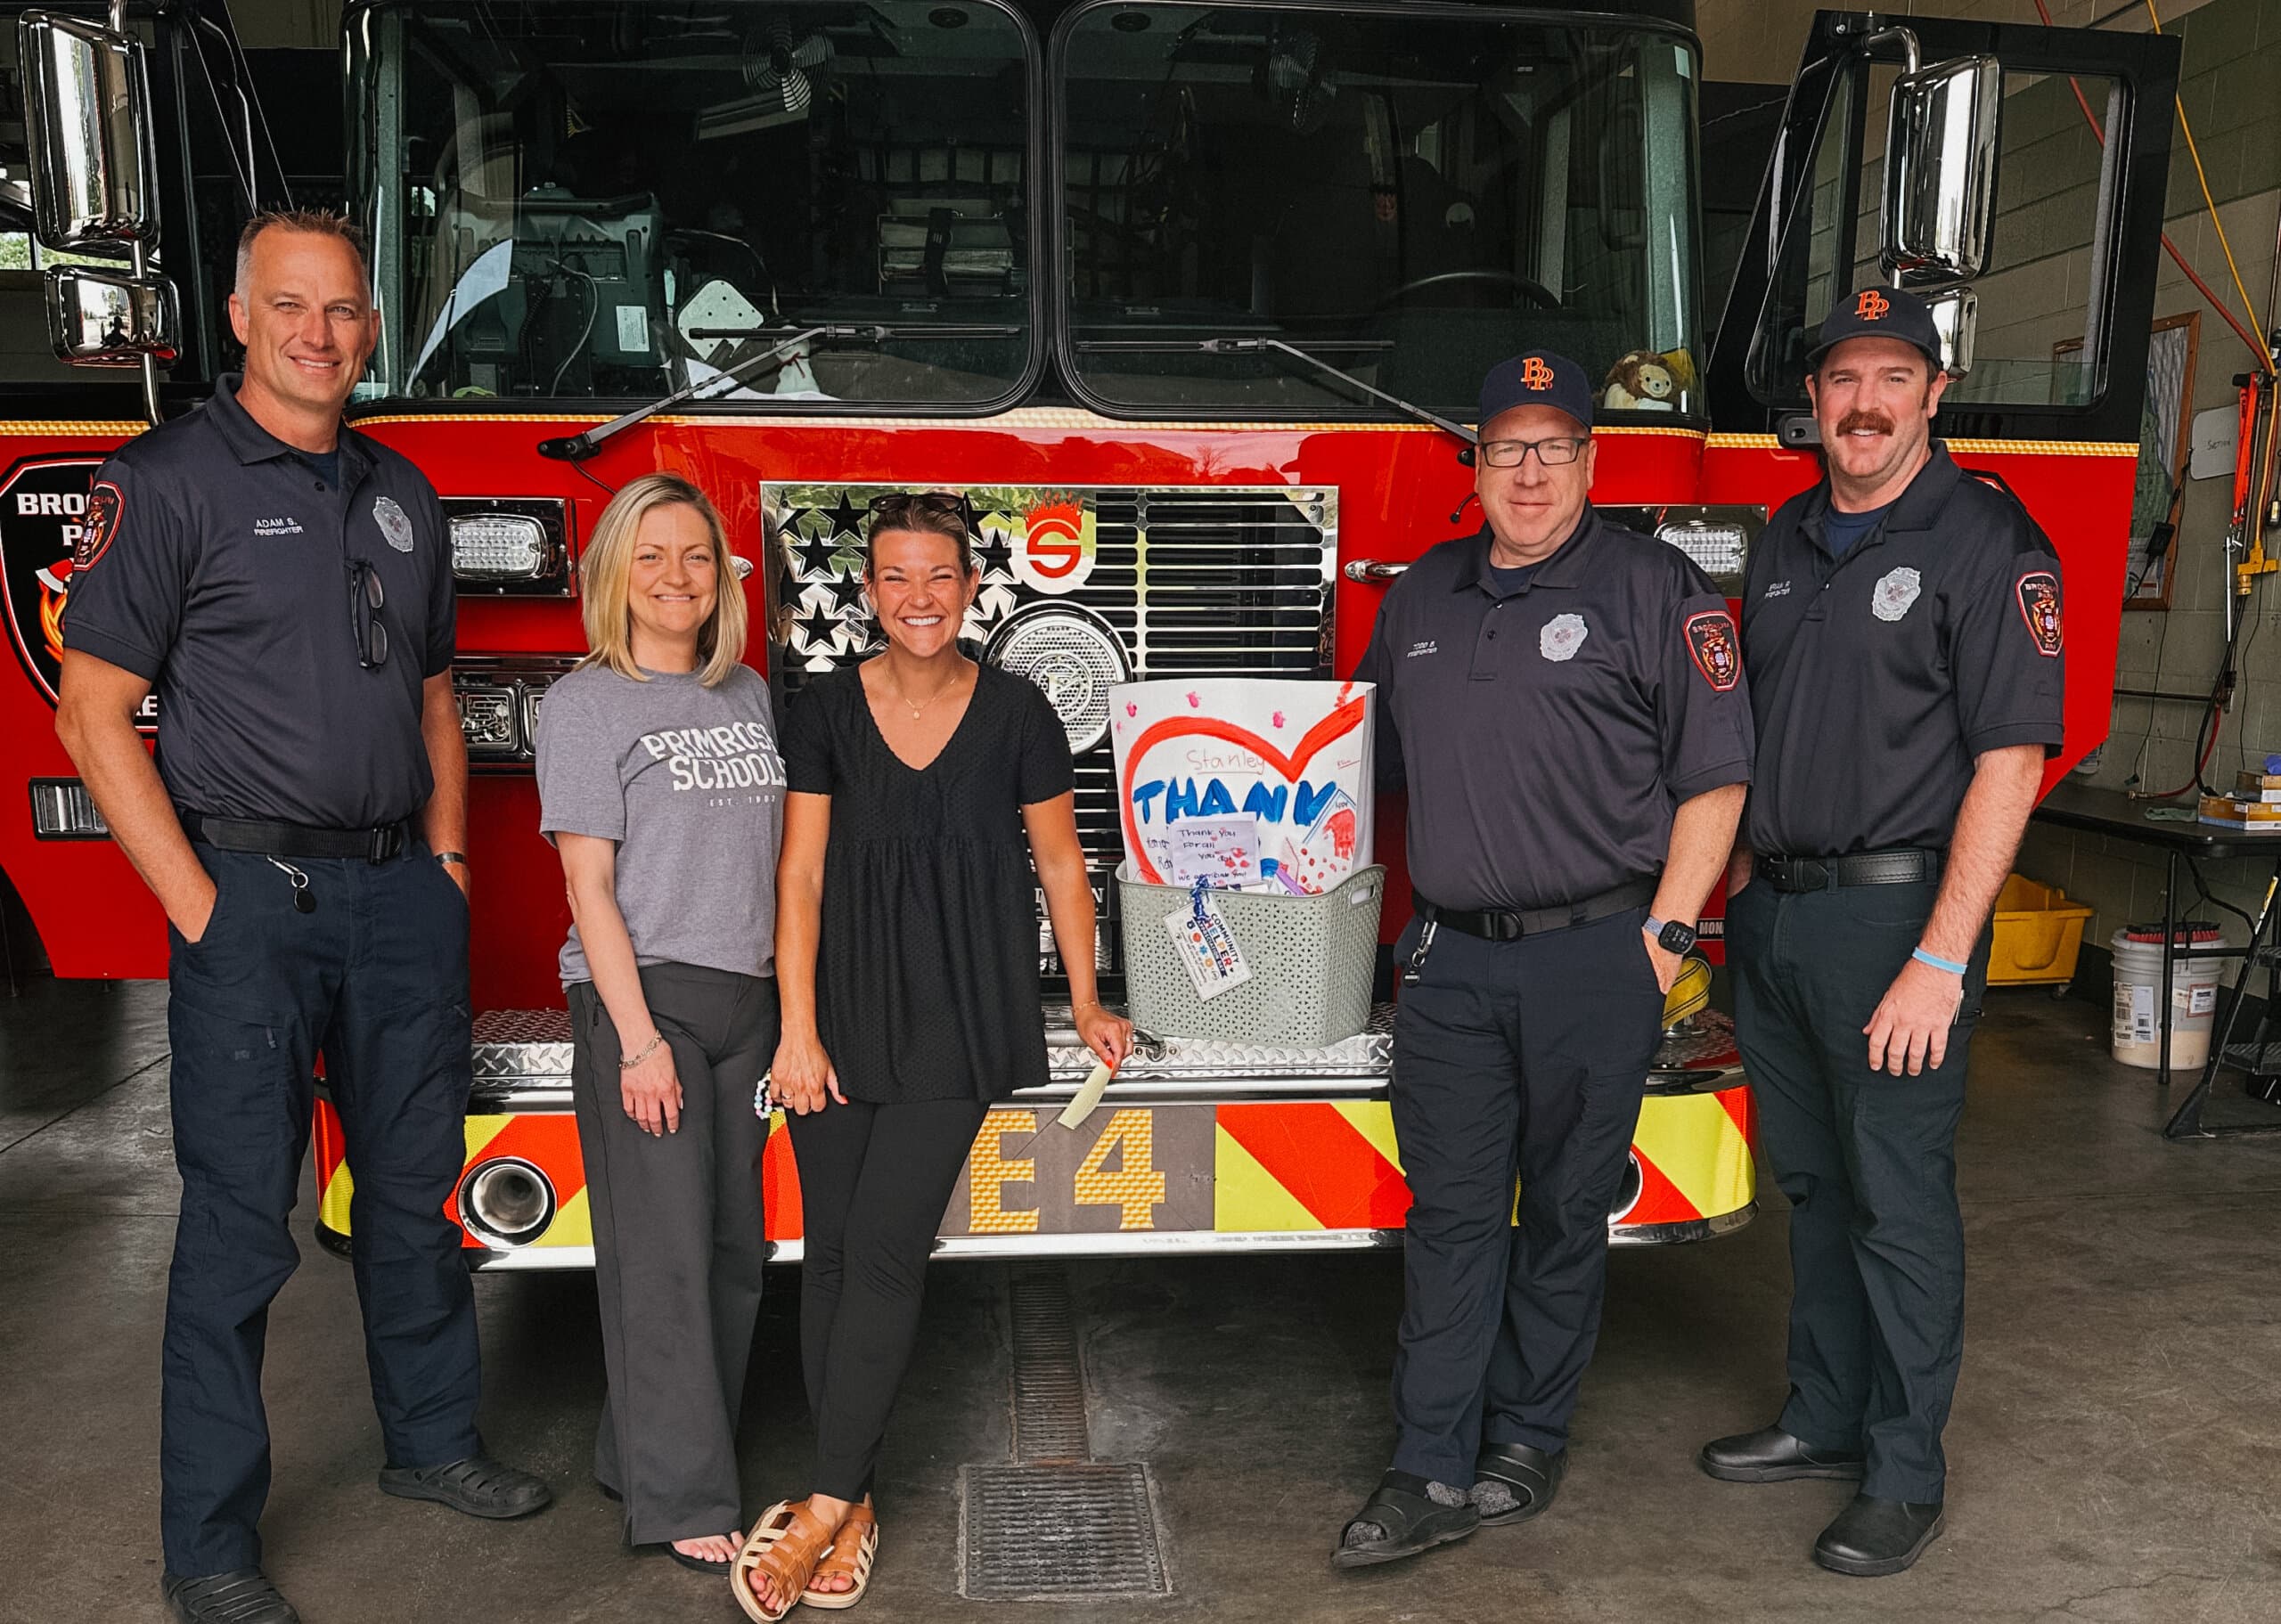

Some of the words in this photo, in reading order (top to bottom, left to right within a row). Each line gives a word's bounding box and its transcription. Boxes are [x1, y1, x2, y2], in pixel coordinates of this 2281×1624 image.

[16, 493, 90, 515] BRO
[257, 518, 284, 527] ADAM
[287, 518, 298, 526] S.
[1186, 748, 1264, 775] Stanley
[1133, 775, 1337, 826] THANK
[1206, 918, 1233, 967] HELPER
[1212, 913, 1239, 963] COMMUNITY
[969, 1110, 1040, 1233] E
[1074, 1109, 1165, 1229] 4
